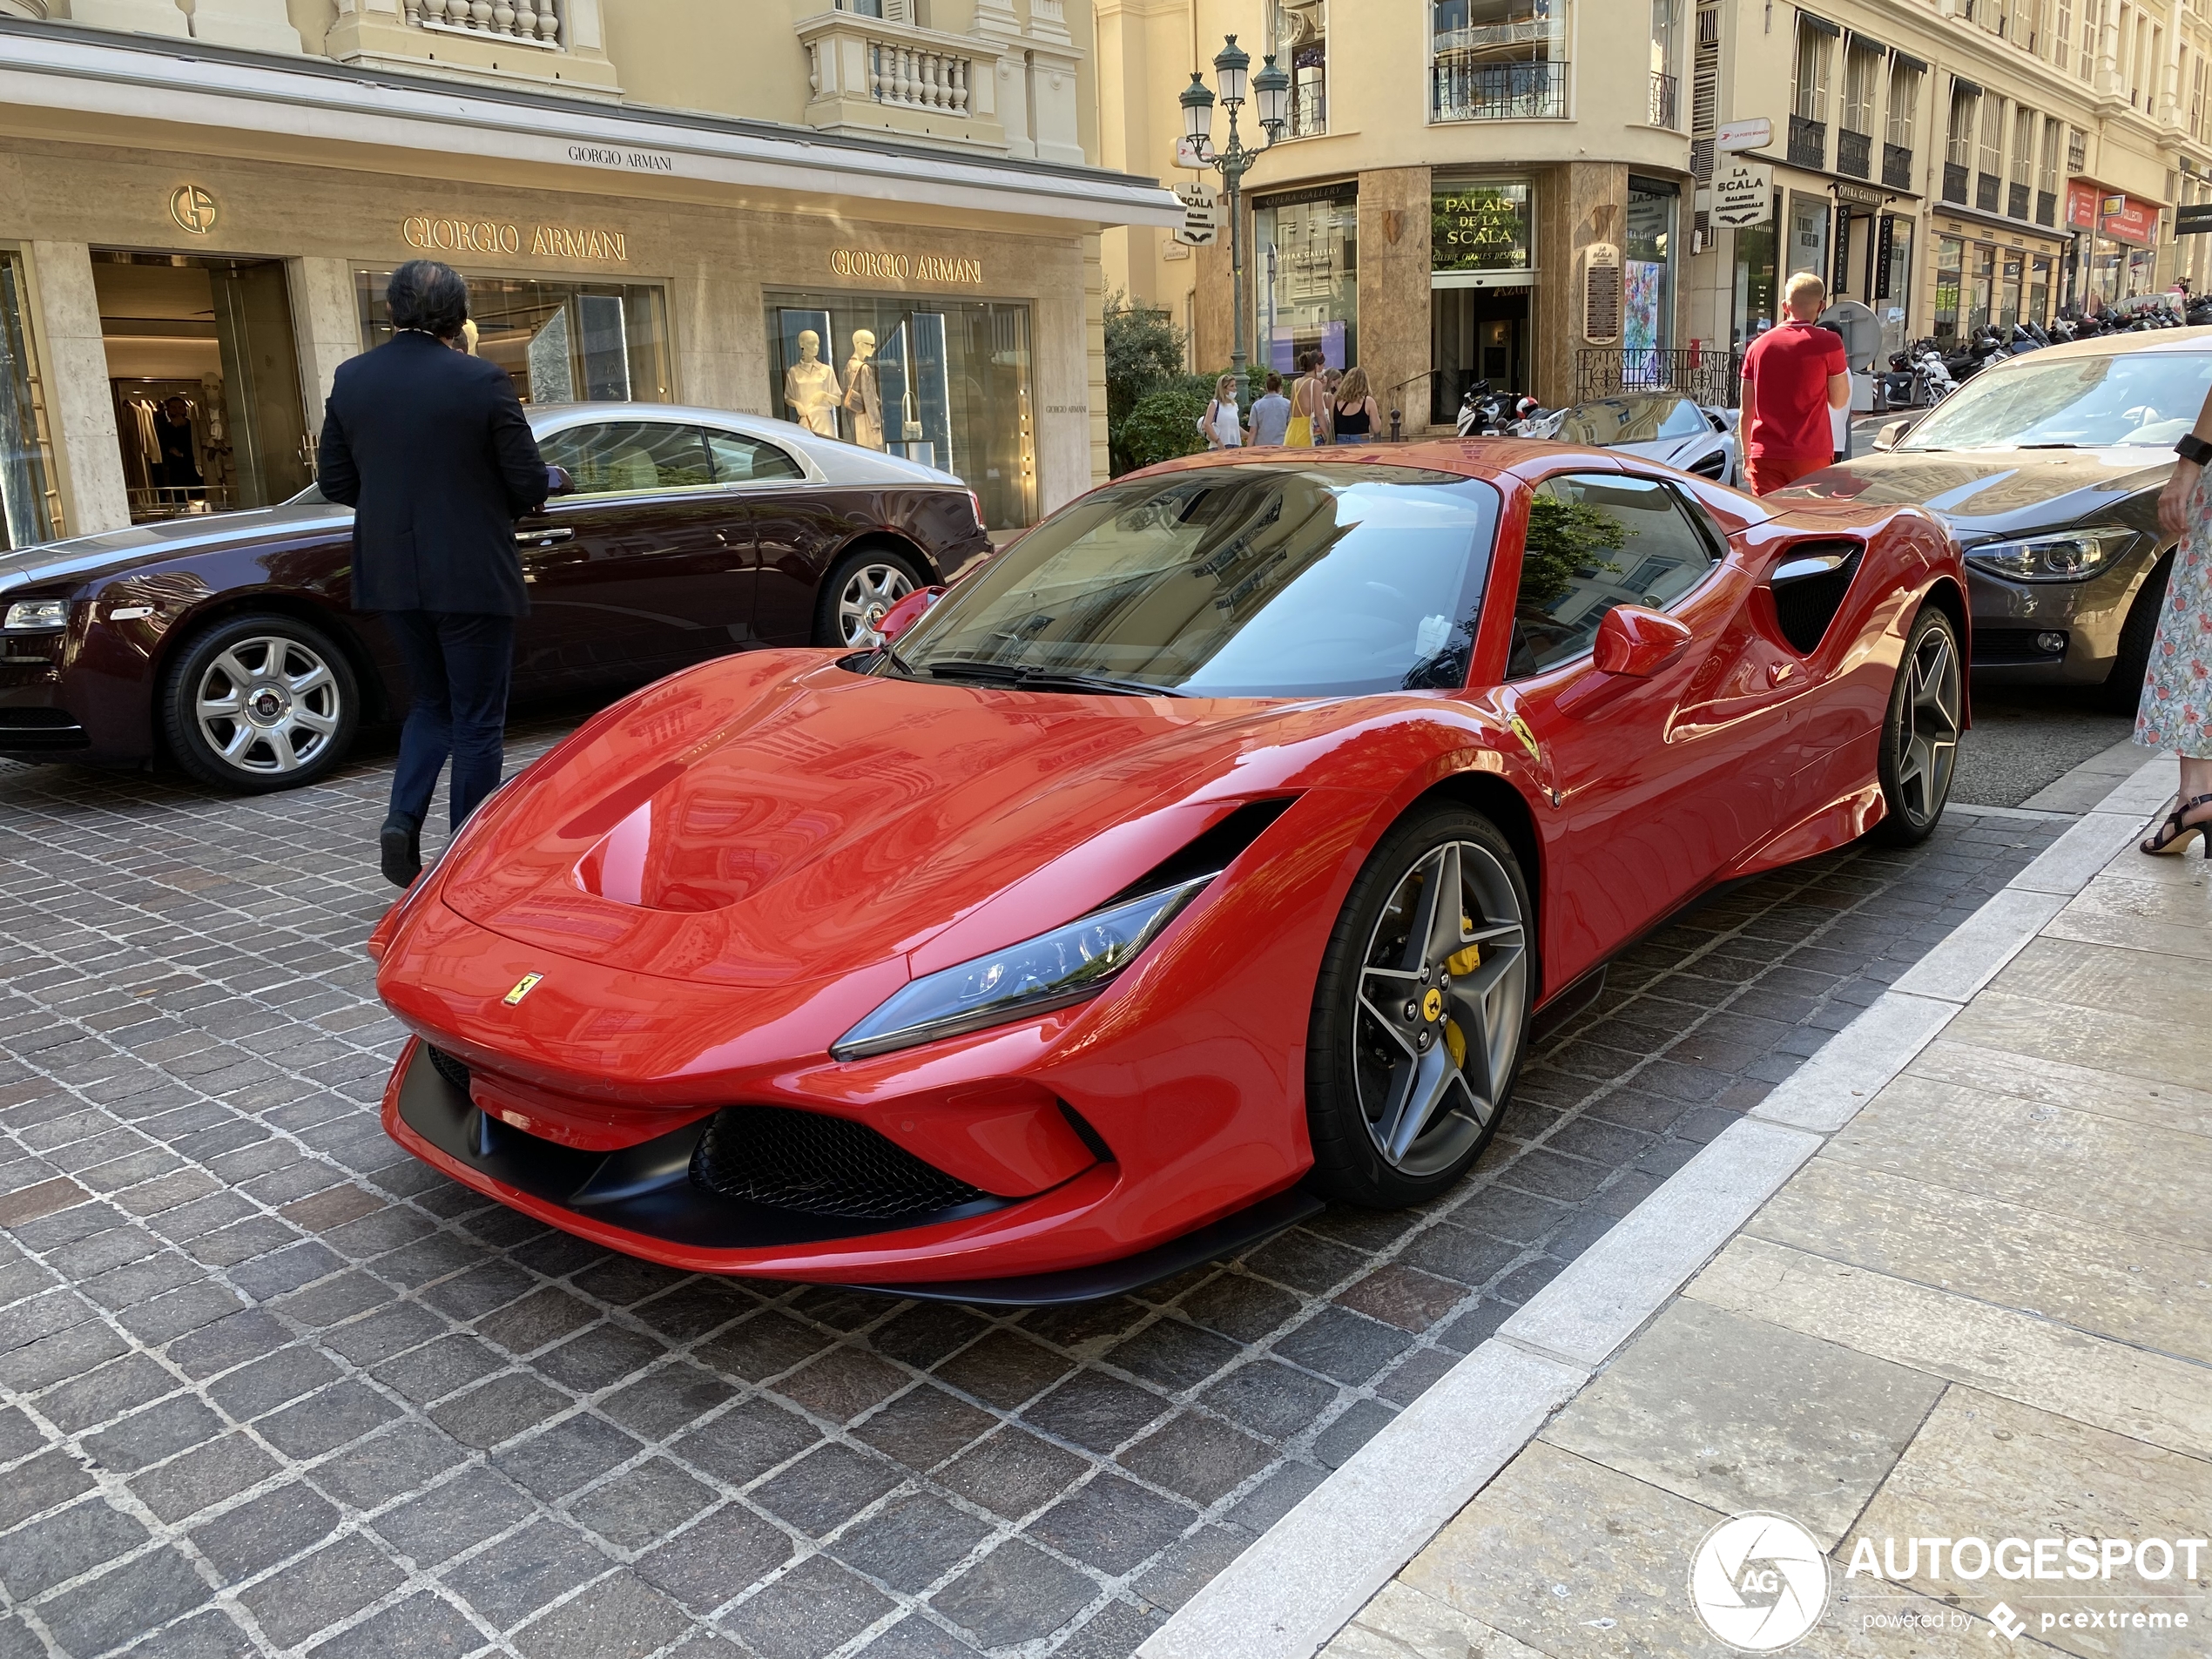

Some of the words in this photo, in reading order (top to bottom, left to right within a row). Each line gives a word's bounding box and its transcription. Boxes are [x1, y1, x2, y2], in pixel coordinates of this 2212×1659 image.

[568, 145, 622, 165] GIORGIO
[625, 153, 672, 171] ARMANI
[1733, 168, 1748, 177] LA
[1190, 185, 1203, 195] LA
[1717, 178, 1764, 192] SCALA
[1265, 194, 1297, 206] OPERA
[1300, 185, 1342, 199] GALLERY
[1724, 193, 1755, 203] GALERIE
[1838, 185, 1858, 198] OPERA
[1858, 190, 1881, 203] GALLERY
[1445, 198, 1514, 212] PALAIS
[1715, 201, 1764, 212] COMMERCIALE
[1459, 216, 1478, 227] DE
[1482, 215, 1502, 226] LA
[403, 217, 519, 254] GIORGIO
[530, 226, 630, 261] ARMANI
[1447, 230, 1514, 245] SCALA
[1882, 219, 1891, 251] OPERA
[1276, 253, 1301, 262] OPERA
[1304, 247, 1339, 258] GALLERY
[1433, 253, 1459, 262] GALERIE
[1461, 252, 1492, 261] CHARLES
[831, 249, 910, 280] GIORGIO
[915, 255, 983, 284] ARMANI
[1045, 405, 1067, 414] GIORGIO
[1068, 405, 1087, 414] ARMANI
